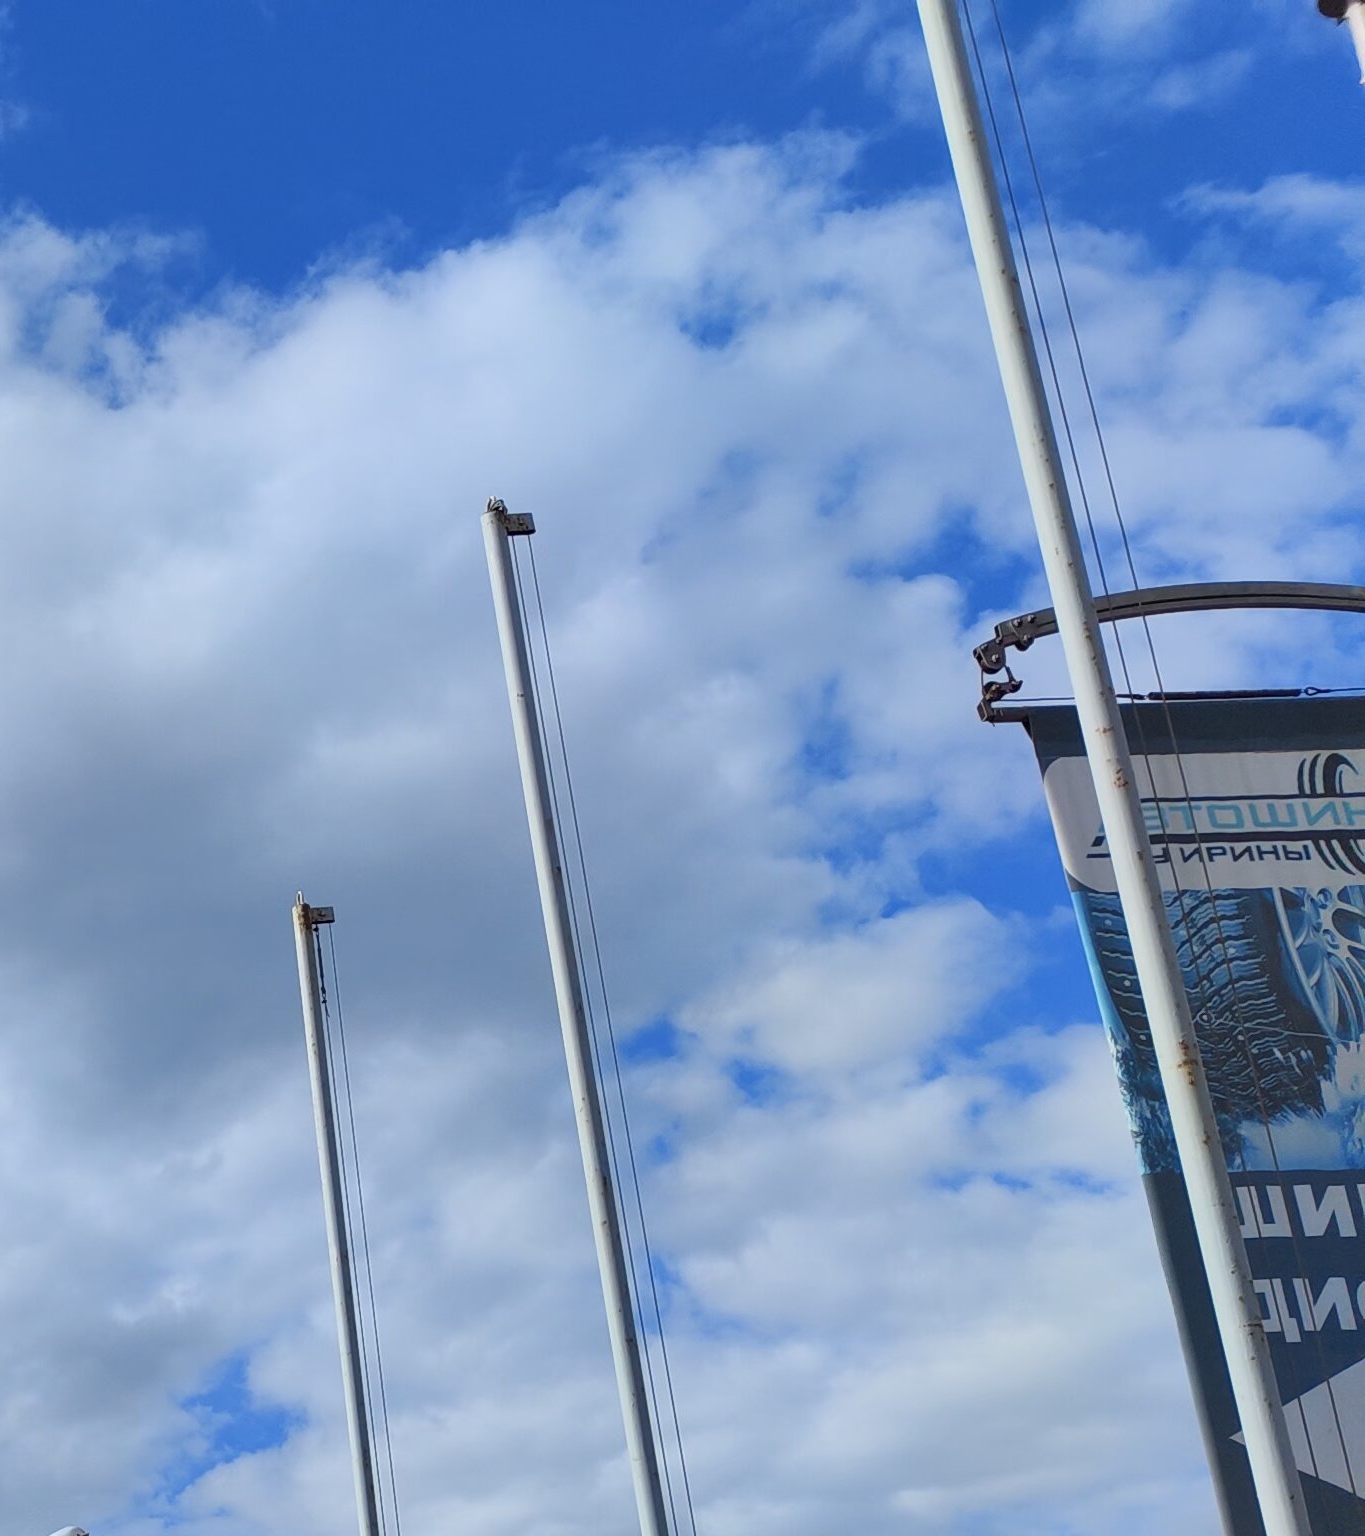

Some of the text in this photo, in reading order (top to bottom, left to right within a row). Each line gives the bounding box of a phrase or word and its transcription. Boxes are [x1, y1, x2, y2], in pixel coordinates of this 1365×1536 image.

[1098, 802, 1365, 833] ВТОШИН
[1179, 844, 1312, 863] ИРИНЫ
[1235, 1183, 1365, 1239] ШИ
[1252, 1276, 1365, 1343] ДИ
